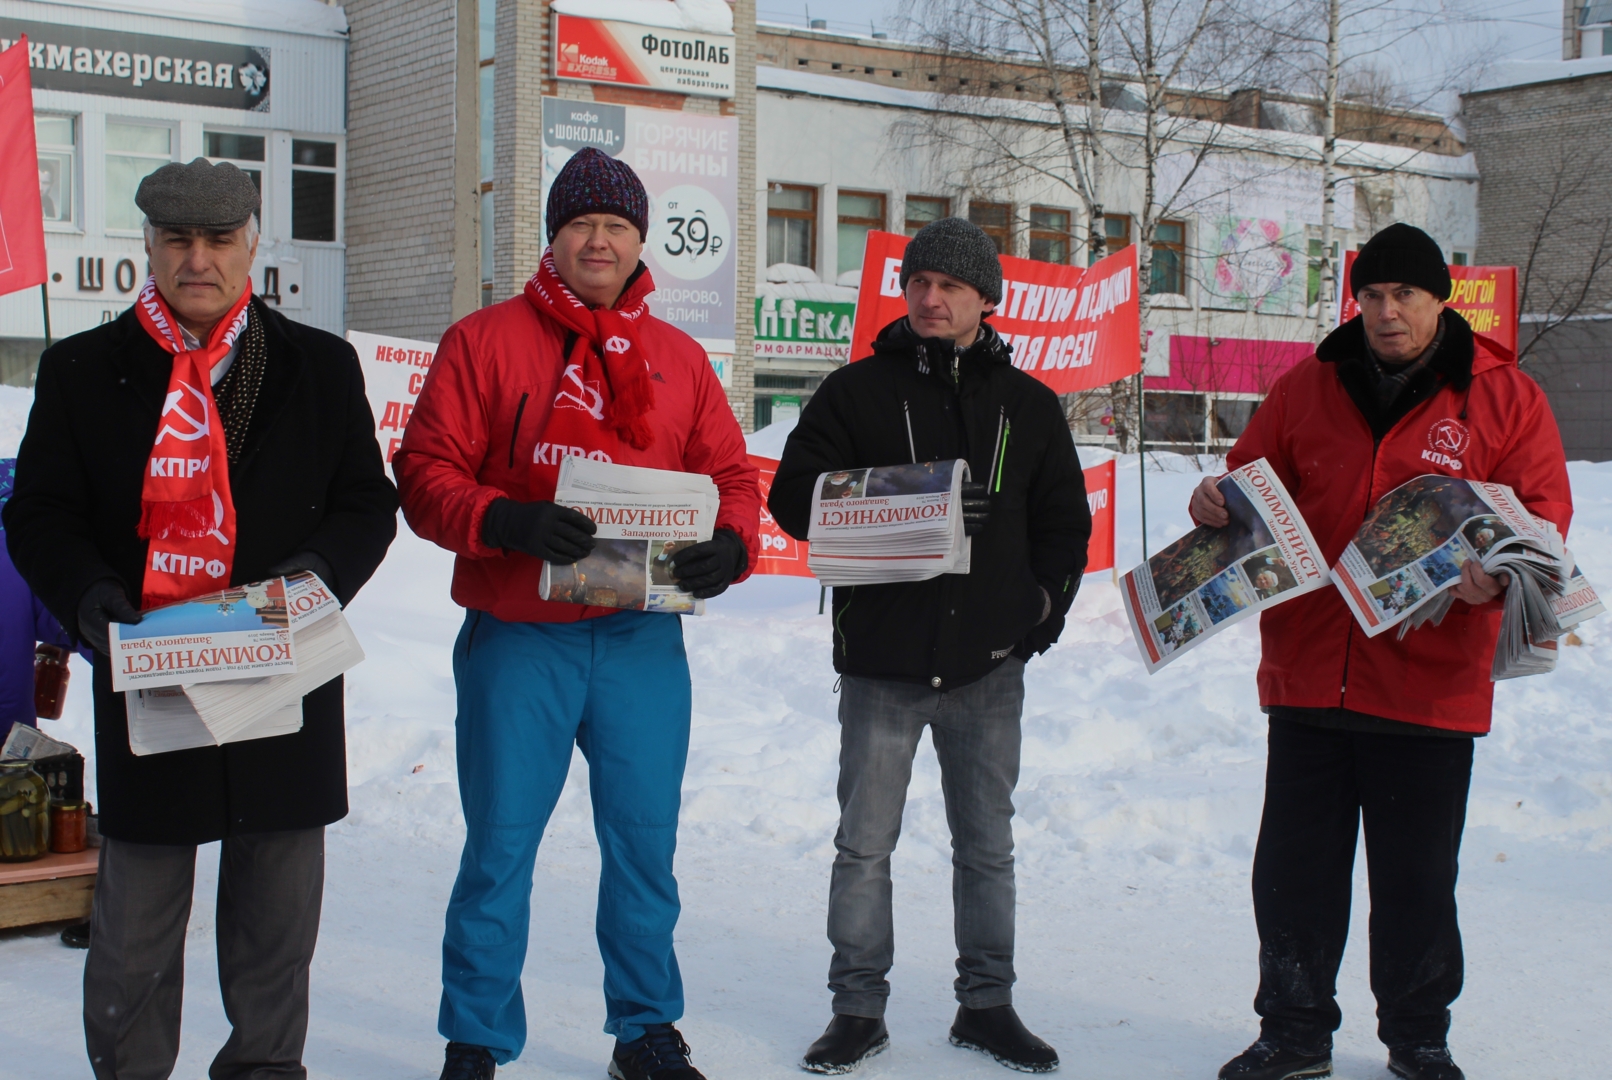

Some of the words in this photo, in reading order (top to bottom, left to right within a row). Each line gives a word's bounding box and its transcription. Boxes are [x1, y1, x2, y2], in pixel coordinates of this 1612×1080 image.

[580, 54, 609, 66] Kodak
[567, 63, 617, 77] EXPRESS
[660, 65, 710, 78] центральная
[677, 77, 729, 90] лаборатория
[570, 110, 599, 125] кафе
[555, 124, 614, 146] ШОКОЛАД
[634, 121, 728, 152] ГОРЯЧИЕ
[634, 147, 728, 178] БЛИНЫ
[653, 288, 723, 307] ЗДОРОВО,
[666, 307, 709, 323] БЛИН!
[754, 308, 851, 340] ПТЕКА
[375, 345, 435, 369] НЕФТЕД
[755, 344, 850, 358] РМФАРМАЦИЯ
[1041, 330, 1098, 370] ВСЕХ!
[1421, 449, 1463, 470] КПРФ
[820, 500, 844, 508] Урала
[846, 498, 890, 506] Западного
[818, 503, 949, 526] КОММУНИСТ
[1242, 464, 1321, 579] КОММУНИСТ
[621, 529, 671, 538] Западного
[673, 530, 698, 539] Урала
[1267, 518, 1292, 560] Западного
[1290, 560, 1305, 585] Урала
[152, 551, 226, 579] КПРФ
[121, 640, 153, 650] Урала
[155, 636, 212, 647] Западного
[122, 643, 292, 674] КОММУНИСТ
